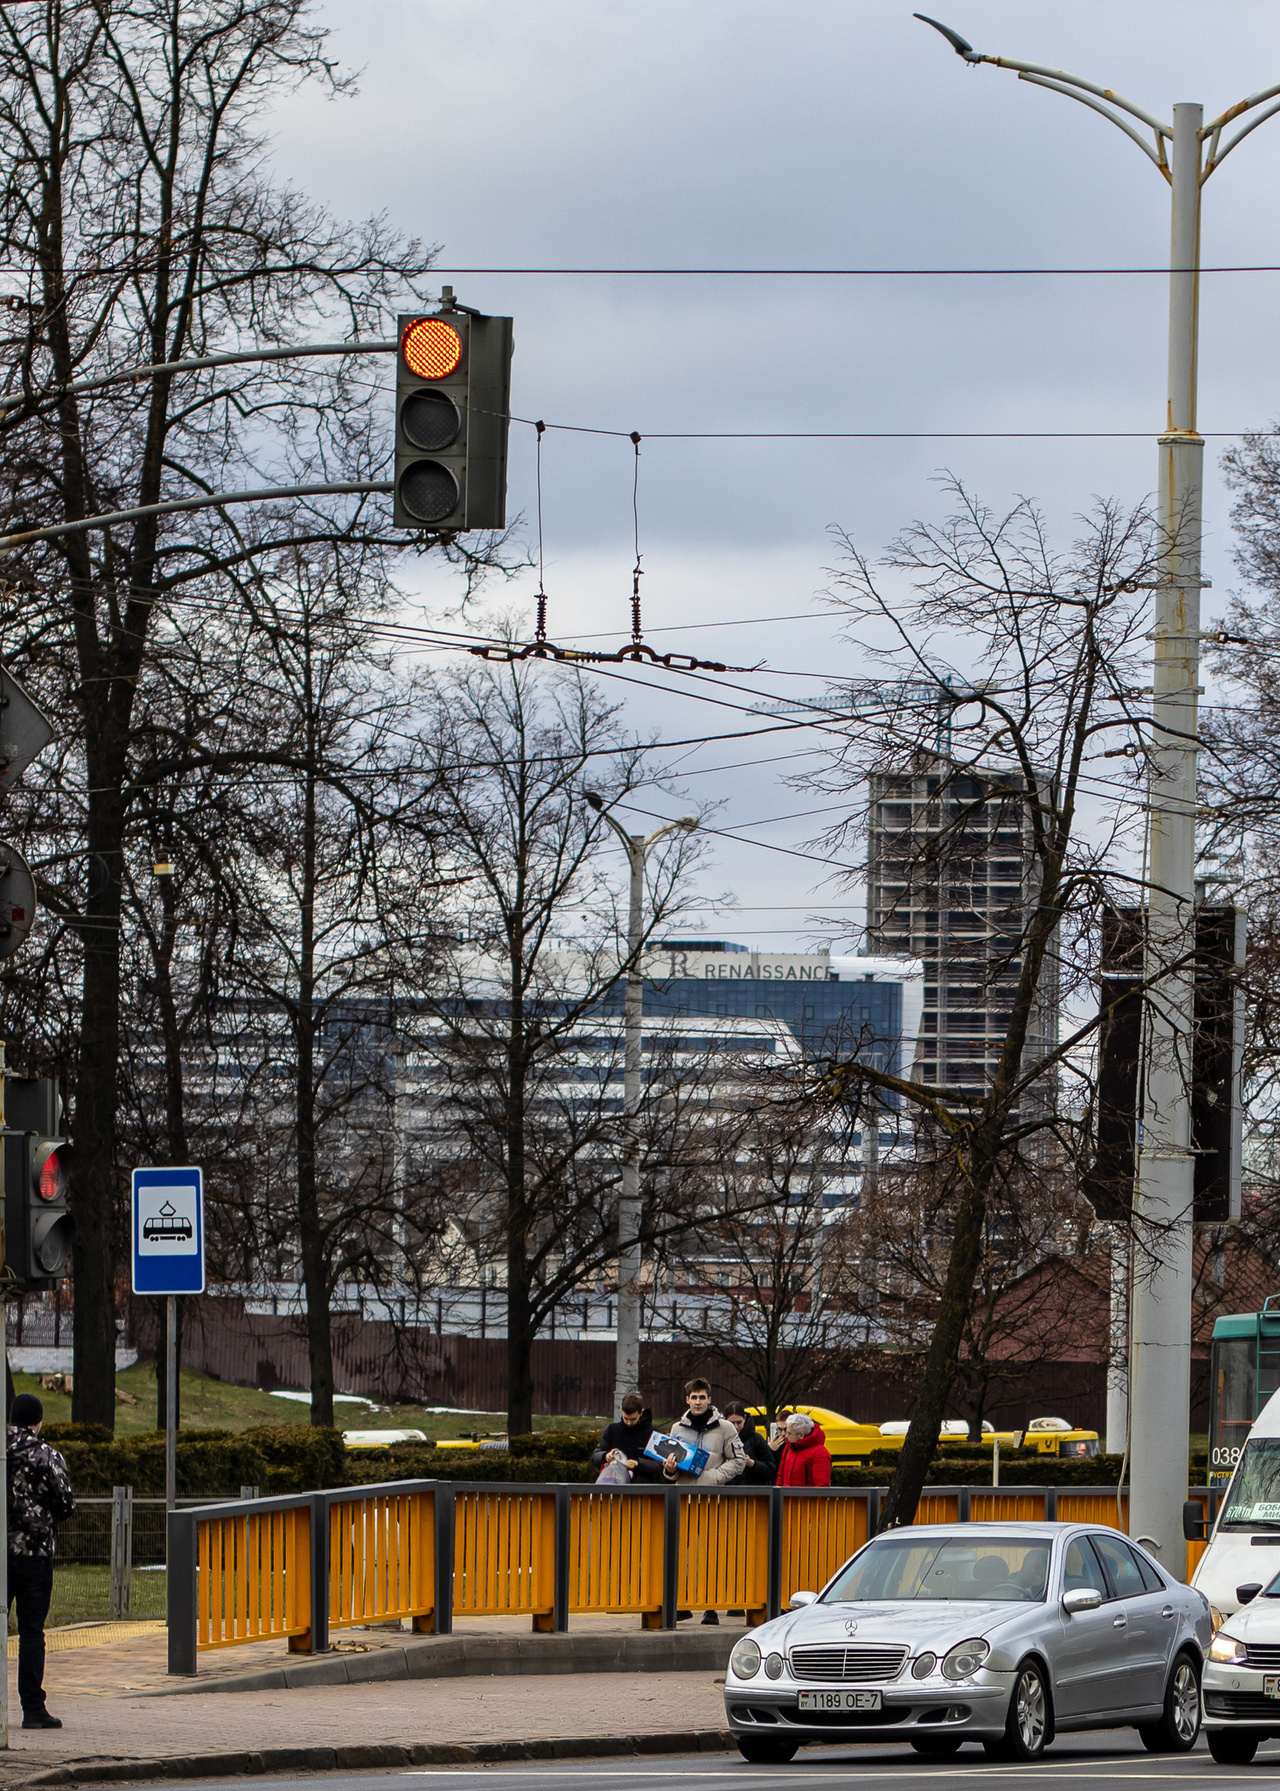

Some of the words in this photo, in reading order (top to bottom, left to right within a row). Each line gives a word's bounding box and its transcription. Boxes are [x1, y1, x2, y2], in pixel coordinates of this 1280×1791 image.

[705, 963, 834, 981] RENAISSANCE
[812, 1693, 841, 1708] 1189
[845, 1693, 879, 1708] OE-7
